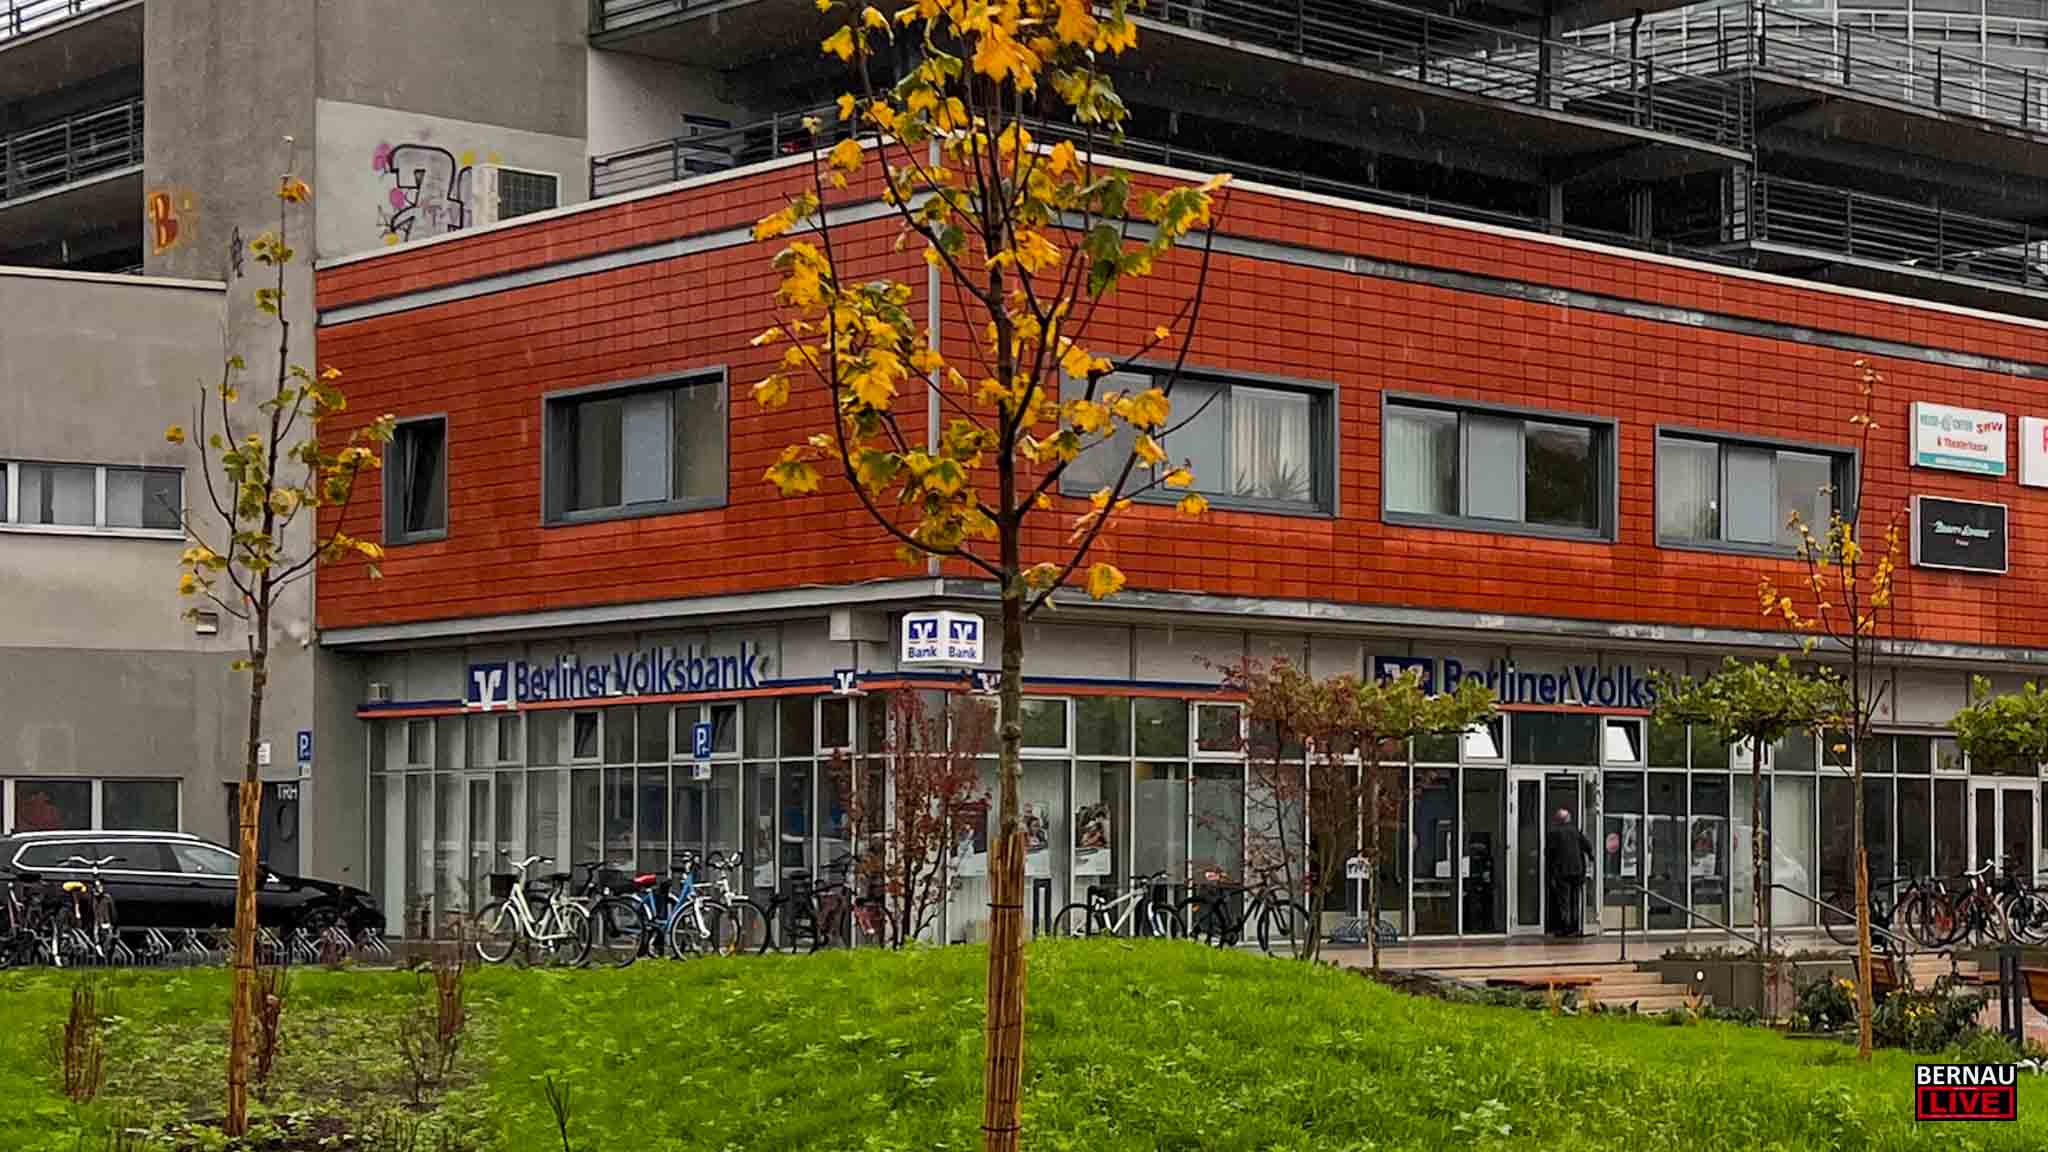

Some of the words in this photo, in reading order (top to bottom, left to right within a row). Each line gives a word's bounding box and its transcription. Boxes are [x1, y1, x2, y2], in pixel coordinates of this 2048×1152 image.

[908, 646, 938, 658] Bank
[948, 646, 977, 658] Bank
[515, 654, 611, 701] Berliner
[613, 640, 758, 696] Volksbank
[300, 734, 309, 759] P
